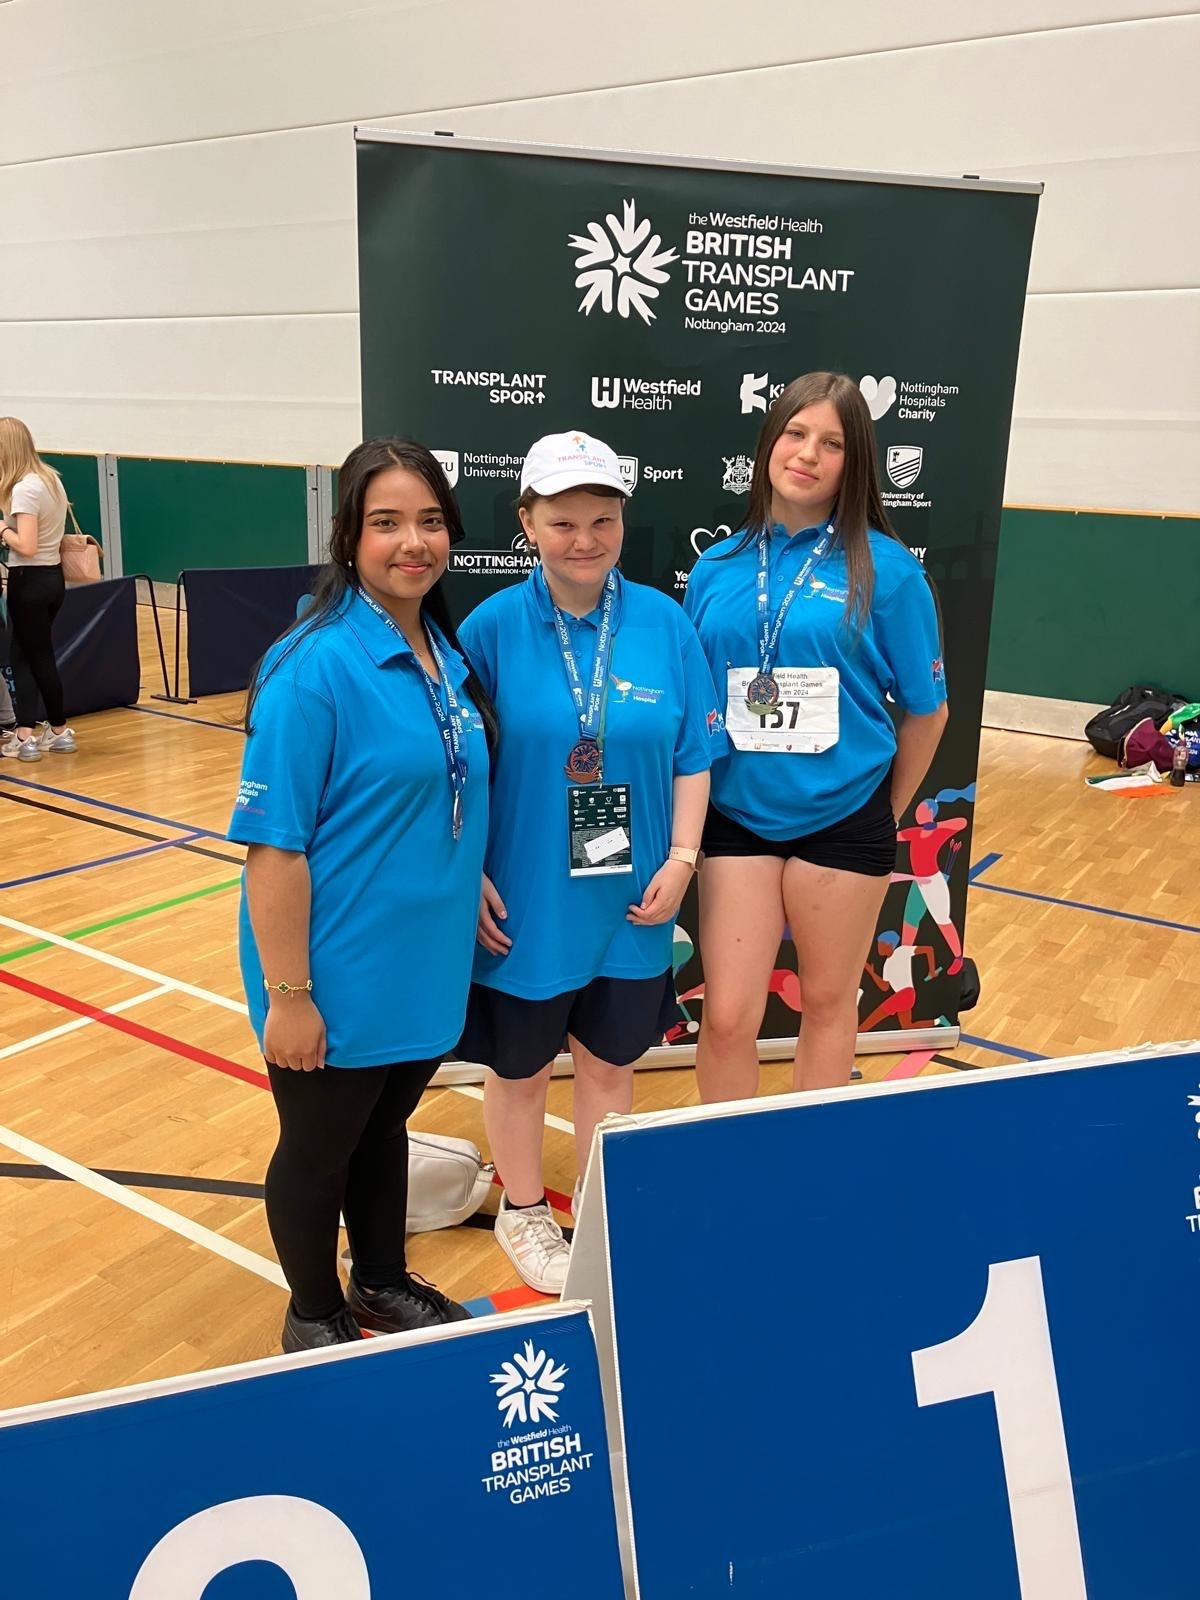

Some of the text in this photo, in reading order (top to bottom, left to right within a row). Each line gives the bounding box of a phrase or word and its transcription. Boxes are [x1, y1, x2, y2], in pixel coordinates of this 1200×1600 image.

[688, 212, 823, 234] the Westfield Health
[686, 230, 792, 260] BRITISH
[681, 259, 855, 292] TRANSPLANT
[684, 289, 779, 316] GAMES
[684, 316, 786, 334] Nottingham 2024
[431, 369, 547, 388] TRANSPLANT
[623, 378, 701, 396] Westfield
[900, 381, 959, 396] Nottingham
[622, 394, 672, 411] Health
[899, 395, 946, 408] Hospitals
[898, 407, 936, 422] Charity
[463, 466, 521, 481] University
[643, 466, 684, 483] Sport
[912, 500, 932, 509] Sport
[916, 492, 925, 500] of
[598, 595, 612, 652] Nottingham 2024
[768, 590, 796, 649] Nottingham 2024
[800, 680, 823, 688] Games
[497, 1424, 572, 1448] the Westfield Health
[911, 1256, 1088, 1600] 1
[491, 1432, 581, 1472] BRITISH
[481, 1453, 594, 1493] TRANSPLANT
[510, 1477, 571, 1505] GAMES
